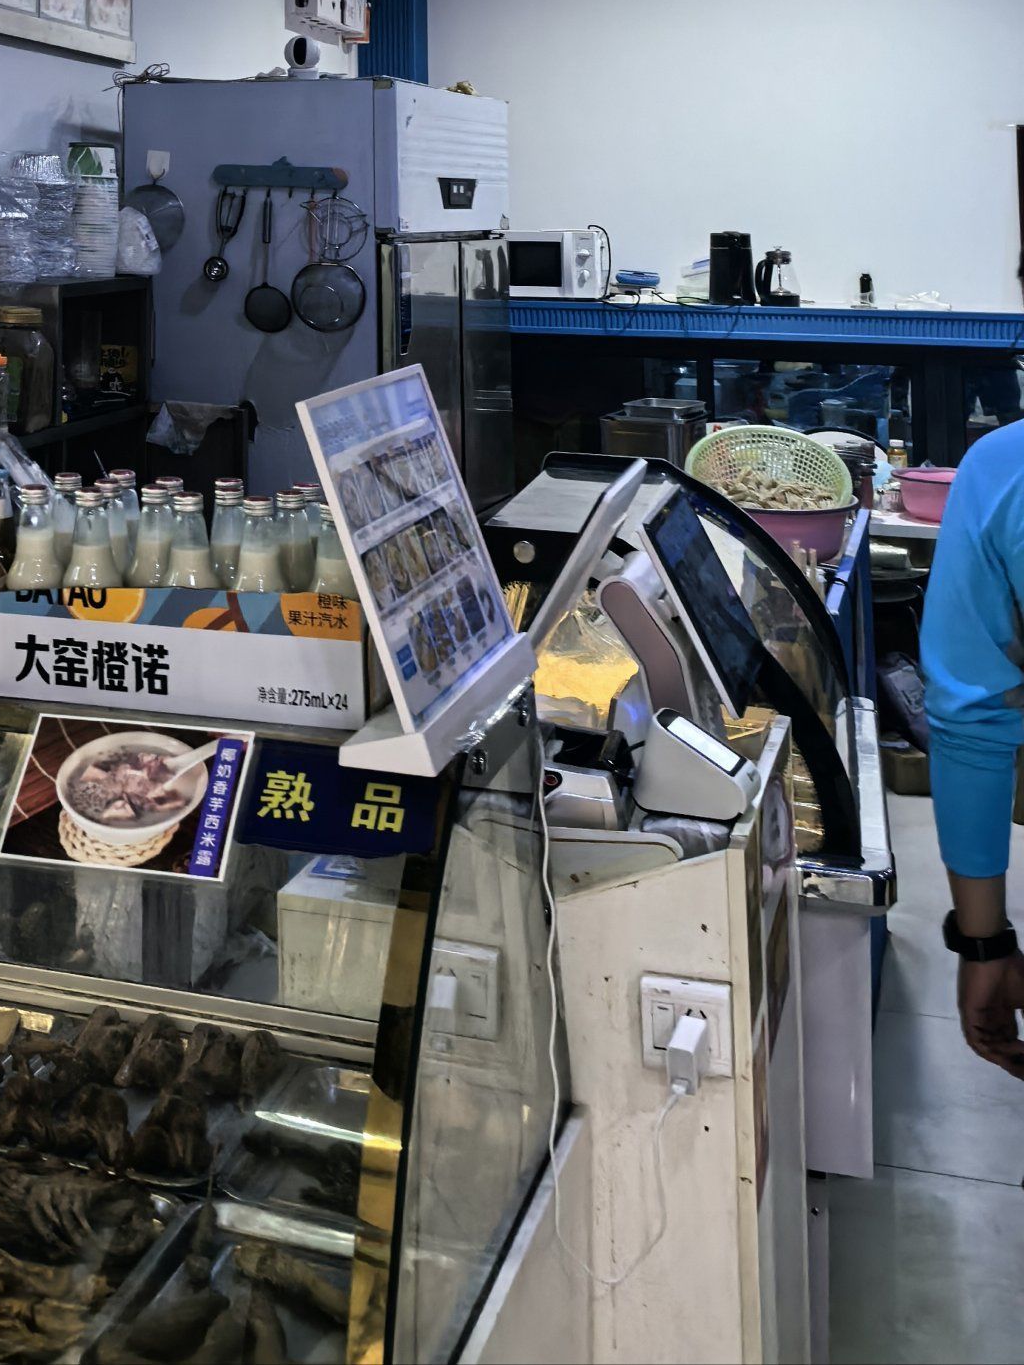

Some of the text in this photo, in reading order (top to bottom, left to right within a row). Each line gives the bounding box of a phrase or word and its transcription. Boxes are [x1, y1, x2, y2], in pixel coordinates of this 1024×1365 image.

[288, 609, 349, 630] 果汁汽水
[14, 634, 170, 696] 大窑橙诺
[257, 770, 405, 833] 熟品
